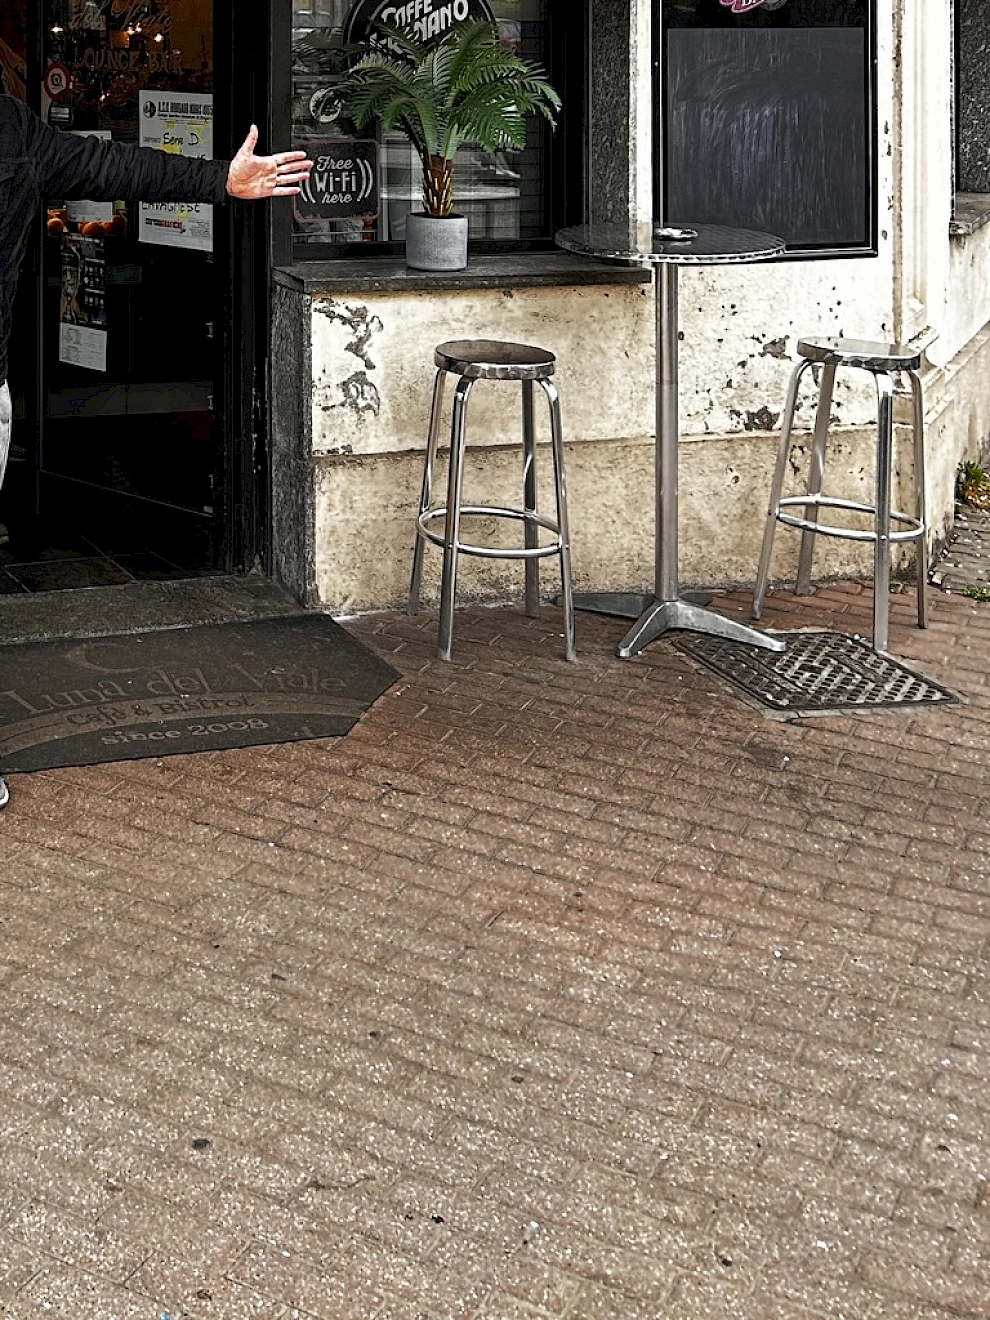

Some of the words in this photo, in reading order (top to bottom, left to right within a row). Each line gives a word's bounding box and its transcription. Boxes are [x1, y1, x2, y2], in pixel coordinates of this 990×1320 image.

[316, 156, 353, 171] Free
[314, 171, 356, 192] Wi-Fi
[321, 191, 353, 204] here
[101, 729, 181, 746] since
[186, 717, 269, 736] 2008
